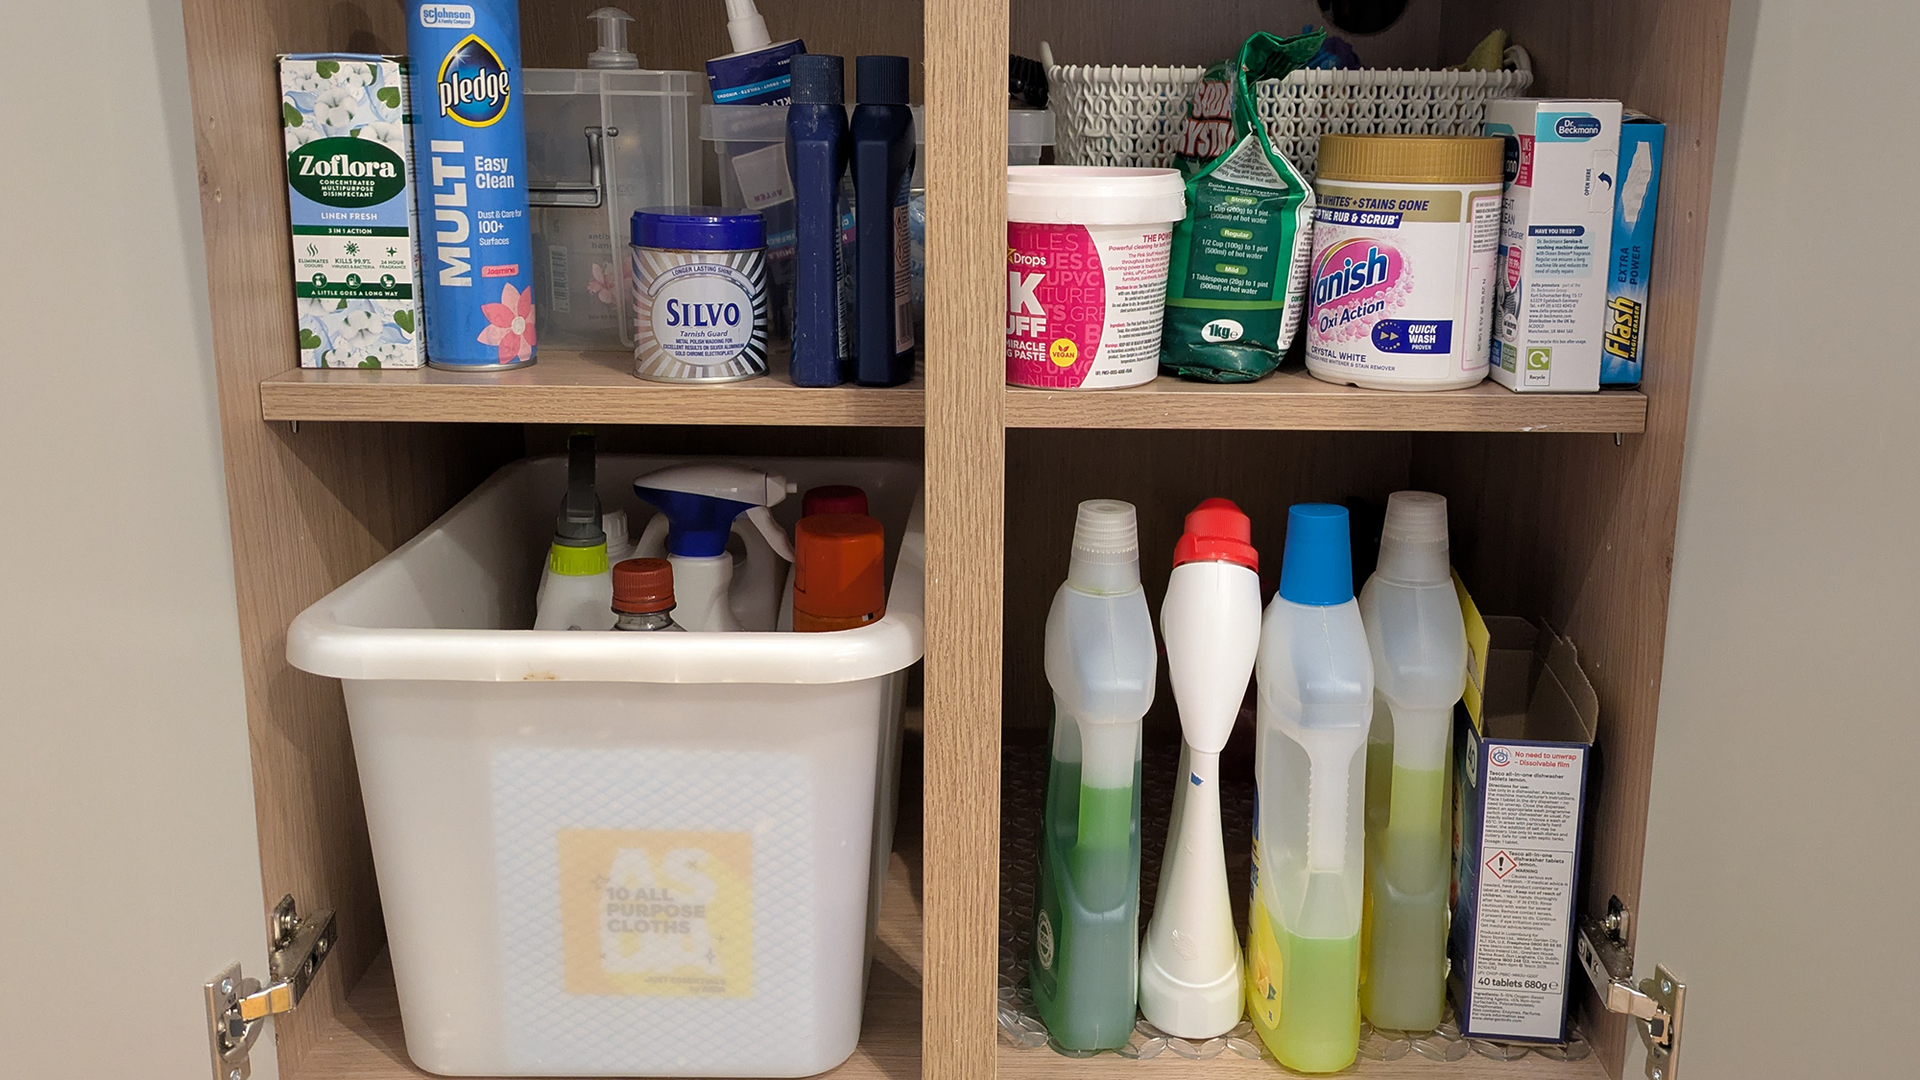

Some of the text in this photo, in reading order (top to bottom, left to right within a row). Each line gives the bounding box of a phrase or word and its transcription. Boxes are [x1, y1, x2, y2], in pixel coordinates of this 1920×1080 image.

[439, 68, 509, 117] pledge
[1559, 126, 1598, 134] Beckmann
[299, 154, 397, 177] Zoflora
[475, 156, 508, 173] Easy
[475, 173, 514, 188] Clean
[754, 190, 782, 201] AFTER
[1358, 198, 1396, 210] STAINS
[1398, 200, 1429, 210] GONE
[431, 140, 472, 286] MULTI
[502, 210, 514, 218] Care
[1322, 210, 1332, 220] THE
[1333, 211, 1350, 222] RUB
[1351, 213, 1358, 222] &
[479, 221, 504, 233] 100+
[1225, 230, 1249, 238] Regular
[1508, 228, 1524, 240] Cleaner
[480, 238, 509, 246] Surfaces
[1018, 231, 1079, 251] TILES
[1143, 234, 1157, 242] THE
[1212, 240, 1223, 248] Cup
[1225, 242, 1243, 250] (100g)
[1205, 247, 1227, 256] (500ml)
[1014, 253, 1046, 267] Drops
[1618, 247, 1629, 282] EXTRA
[1630, 246, 1640, 285] POWER
[672, 266, 692, 276] LONGER
[718, 267, 732, 276] SHINE
[1046, 271, 1099, 286] UPVC
[1196, 274, 1228, 284] Tablespoon
[1229, 278, 1244, 286] (20g)
[1309, 247, 1390, 318] Vanish
[1200, 282, 1221, 291] (500ml)
[667, 299, 739, 326] SILVO
[1320, 300, 1385, 333] Oxi Action
[1006, 315, 1046, 337] UFF
[1208, 322, 1231, 339] 1kg
[1408, 325, 1437, 334] QUICK
[1604, 296, 1634, 358] Flash
[1409, 334, 1436, 343] WASH
[1014, 350, 1046, 361] PASTE
[1311, 346, 1336, 358] CRYSTAL
[1339, 353, 1366, 362] WHITE
[606, 887, 674, 901] 10 ALL
[607, 904, 705, 918] PURPOSE
[607, 919, 690, 934] CLOTHS
[1478, 978, 1547, 991] 40 tablets 680g
